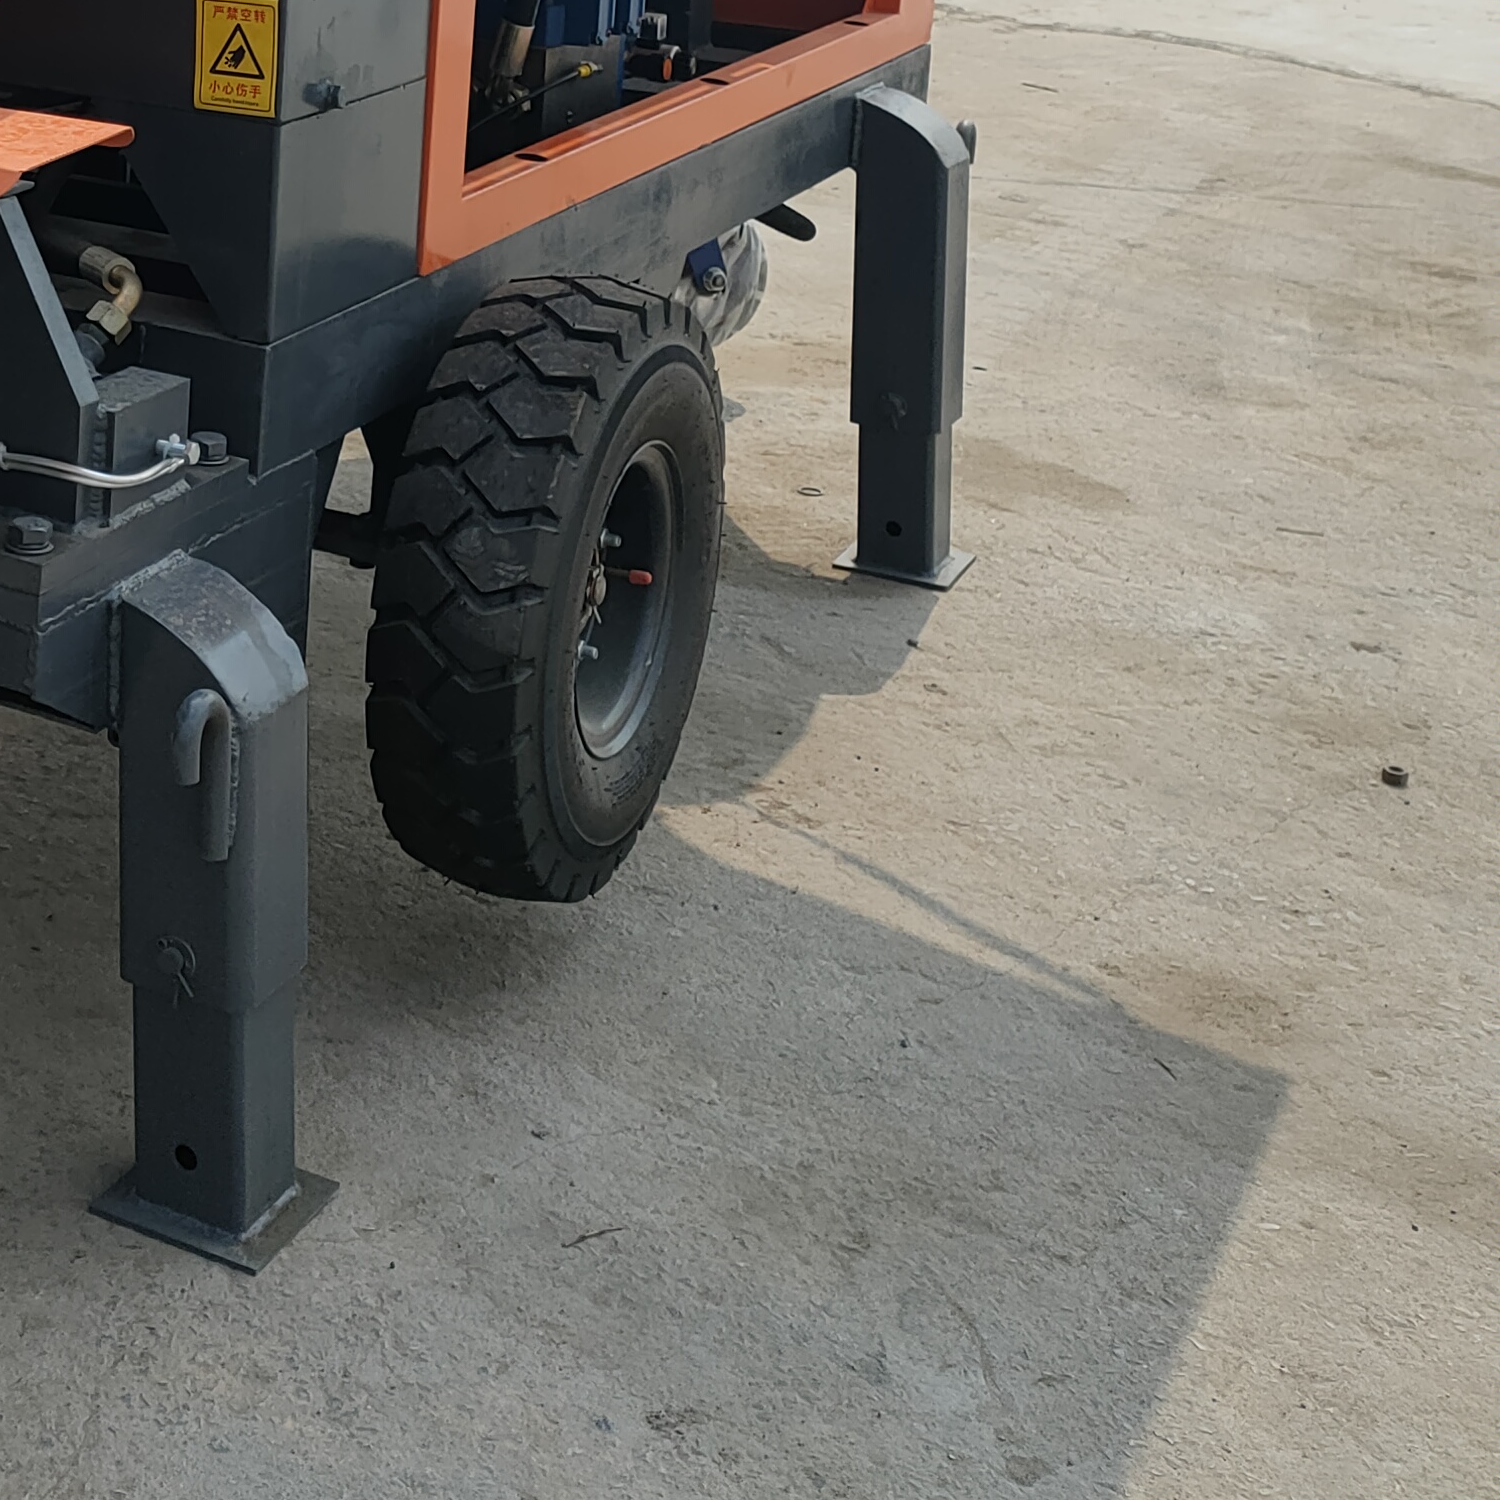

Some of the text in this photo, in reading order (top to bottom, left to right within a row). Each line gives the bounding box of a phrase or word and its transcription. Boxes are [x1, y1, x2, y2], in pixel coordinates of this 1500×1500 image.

[212, 4, 267, 24] 严禁空转
[208, 80, 262, 99] 小心伤手
